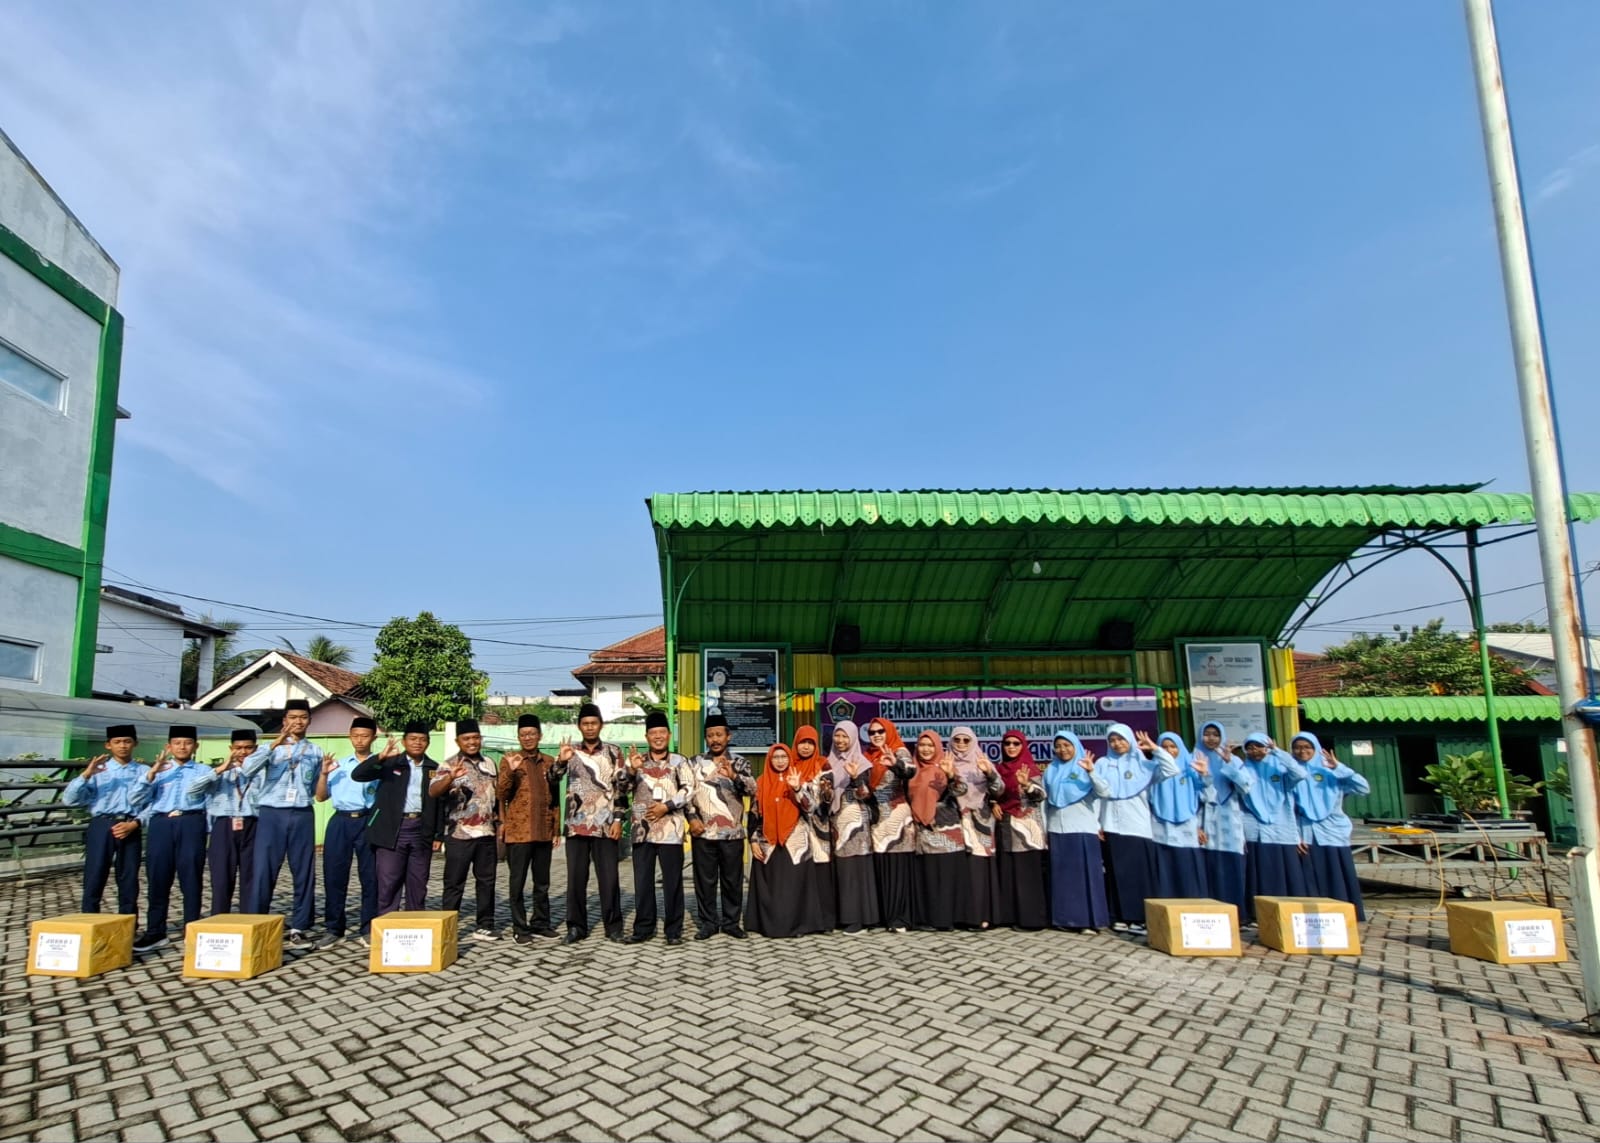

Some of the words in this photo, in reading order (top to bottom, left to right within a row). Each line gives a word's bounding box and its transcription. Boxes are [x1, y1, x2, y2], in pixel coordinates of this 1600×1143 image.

[880, 700, 950, 719] PEMBINAAN
[952, 699, 1010, 718] KARAKTER
[1013, 699, 1061, 717] PESERTA
[1063, 698, 1097, 717] DIDIK
[1035, 724, 1052, 737] DAN
